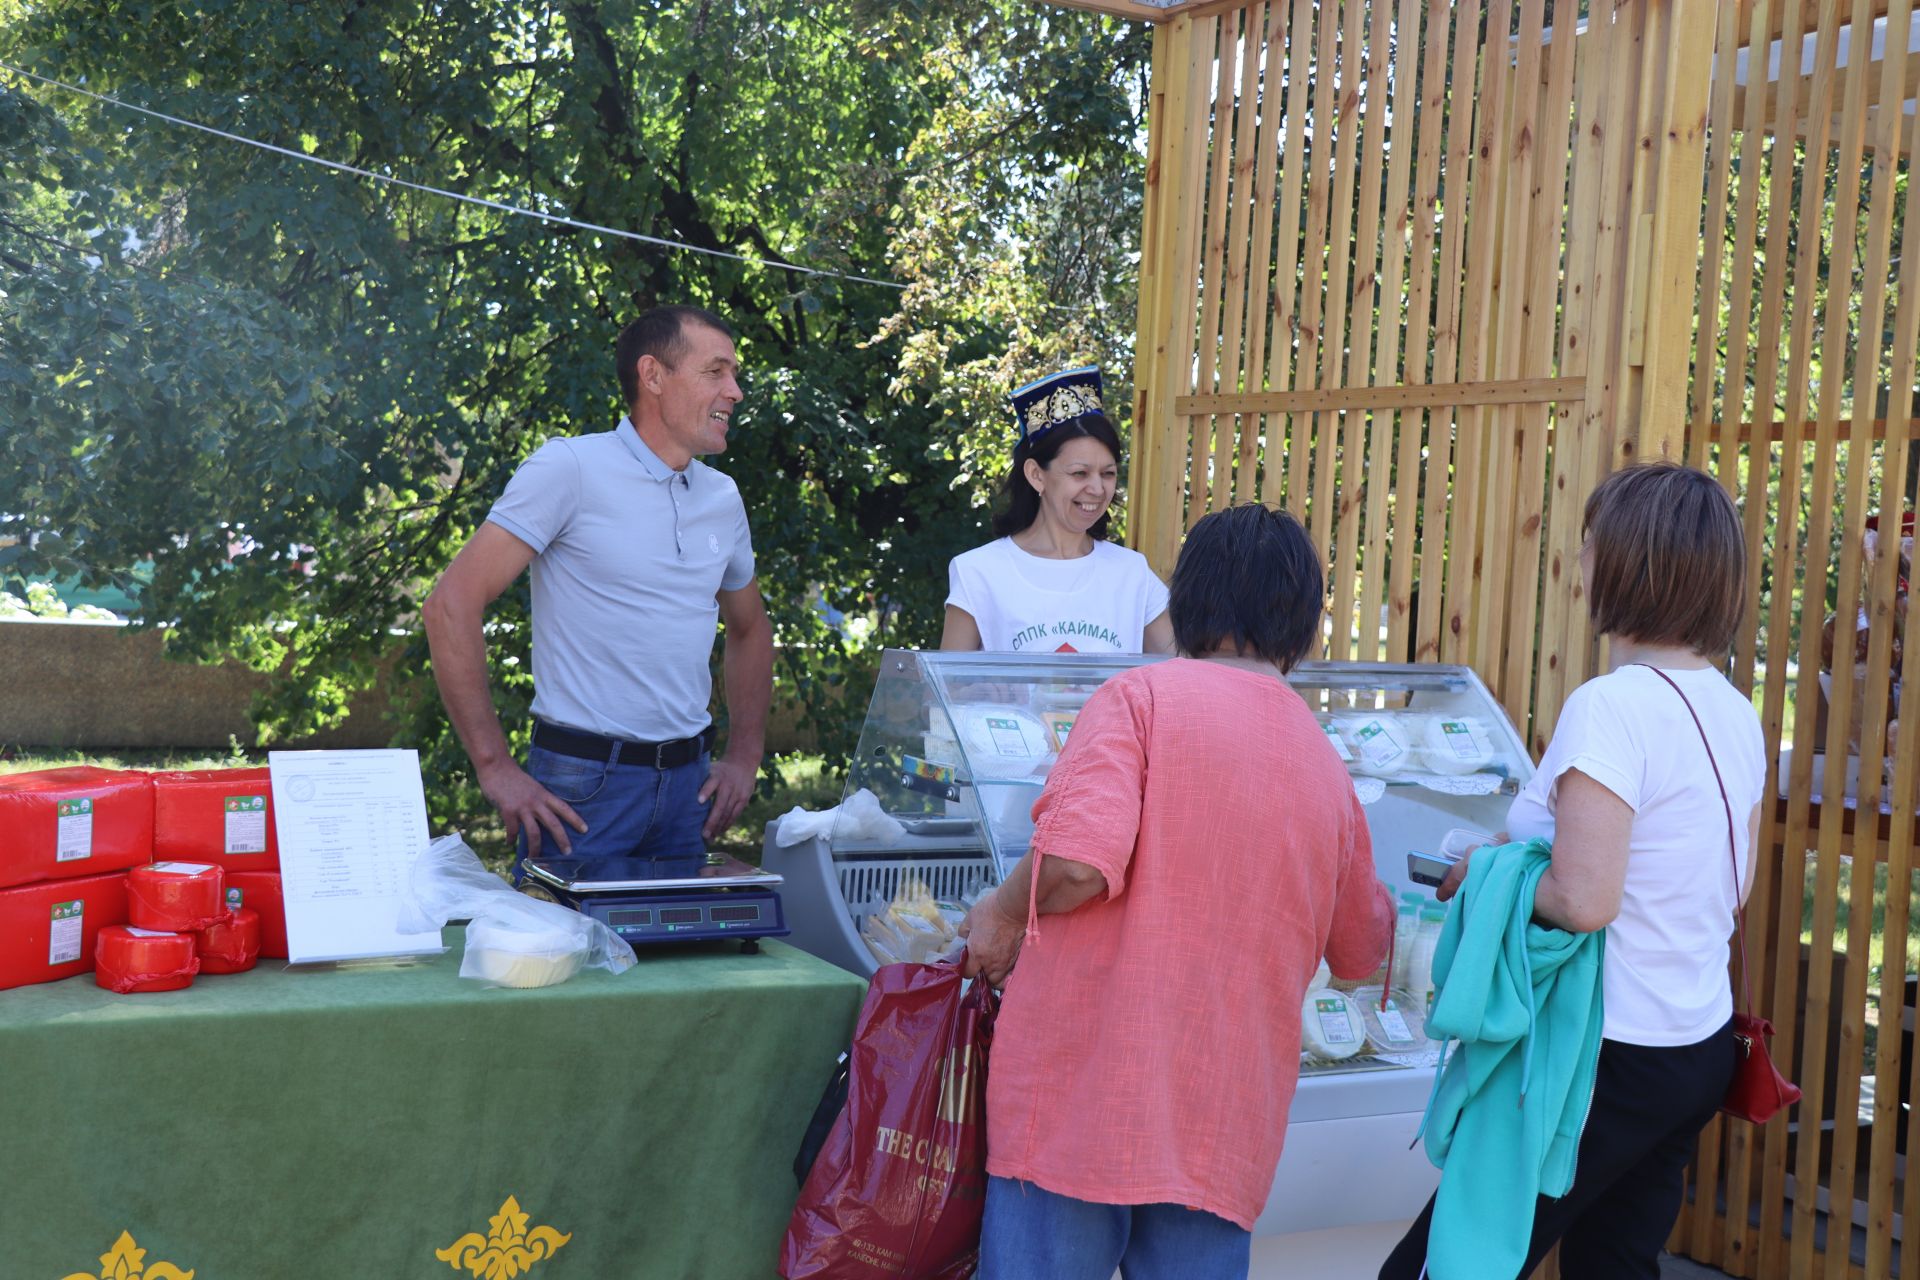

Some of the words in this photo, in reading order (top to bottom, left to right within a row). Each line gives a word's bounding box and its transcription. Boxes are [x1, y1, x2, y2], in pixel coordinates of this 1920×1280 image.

[1012, 623, 1047, 651] СППК
[1051, 619, 1122, 649] «КАЙМАК»
[876, 1126, 913, 1159] THE
